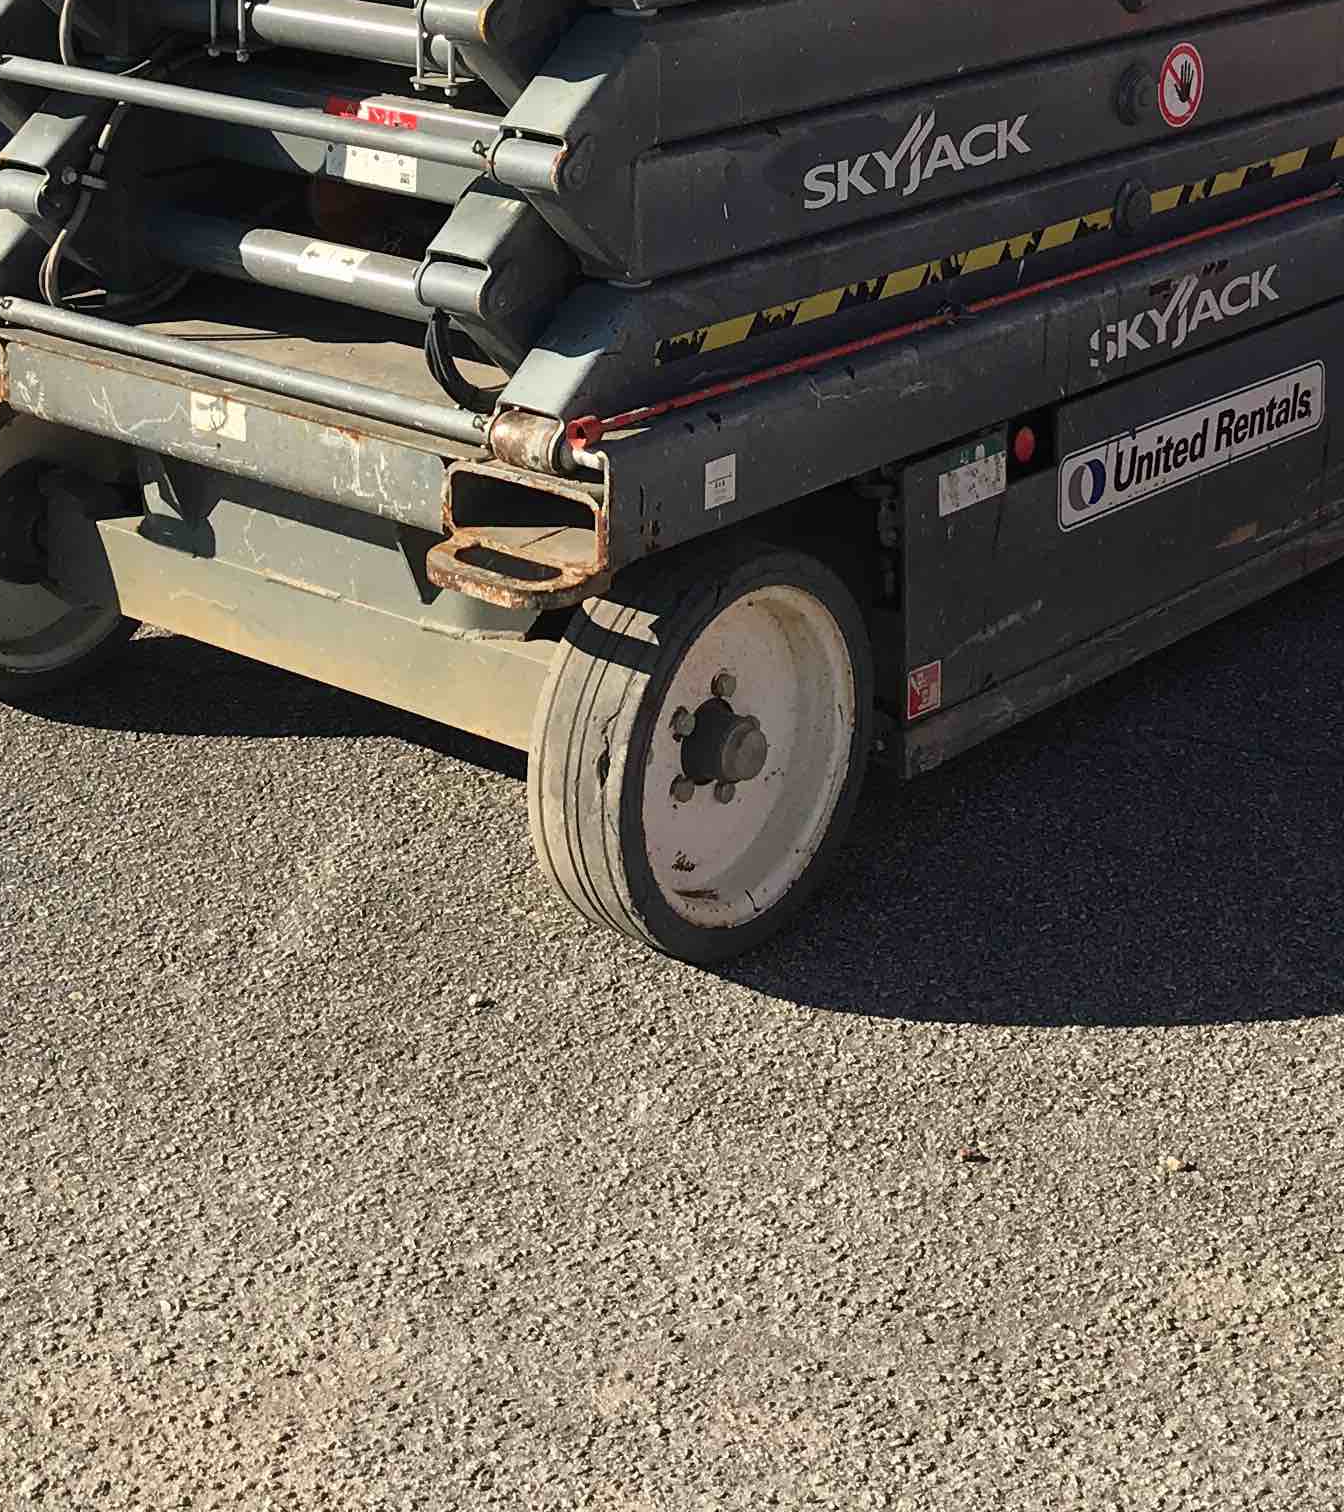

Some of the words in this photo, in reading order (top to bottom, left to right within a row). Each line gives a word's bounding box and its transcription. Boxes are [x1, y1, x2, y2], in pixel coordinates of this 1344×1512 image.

[803, 109, 1032, 209] SKYJACK
[1088, 264, 1281, 368] SKYJACK
[1113, 417, 1209, 492] United
[1213, 382, 1312, 452] Rentals
